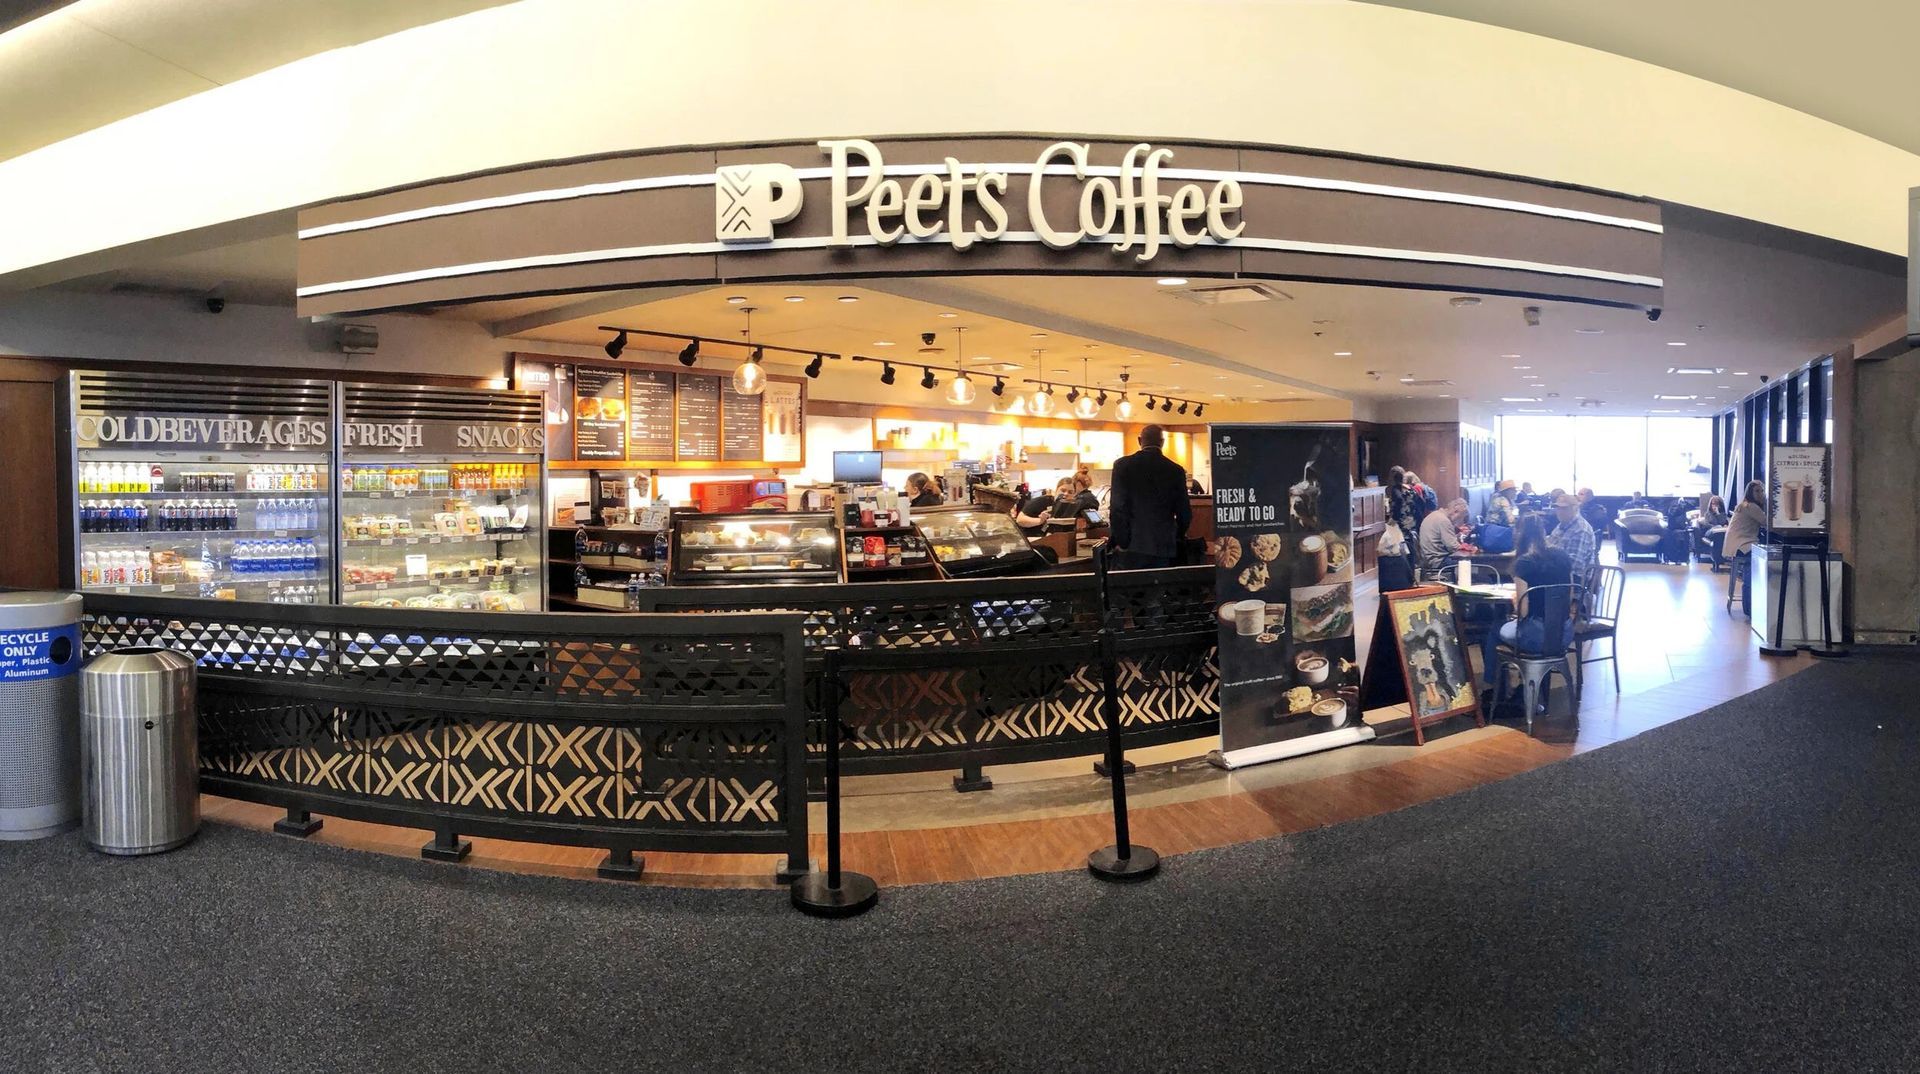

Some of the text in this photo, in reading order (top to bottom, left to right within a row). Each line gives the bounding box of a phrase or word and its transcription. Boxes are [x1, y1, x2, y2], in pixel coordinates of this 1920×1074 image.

[1028, 141, 1246, 264] Coffee
[343, 422, 544, 448] FRESH SNACKS
[1216, 487, 1256, 504] FRESH &
[1217, 505, 1275, 523] READY TO GO
[0, 632, 49, 645] ECYCLE
[4, 645, 37, 657] ONLY
[0, 656, 50, 668] per, Plastic
[5, 668, 49, 677] Aluminum
